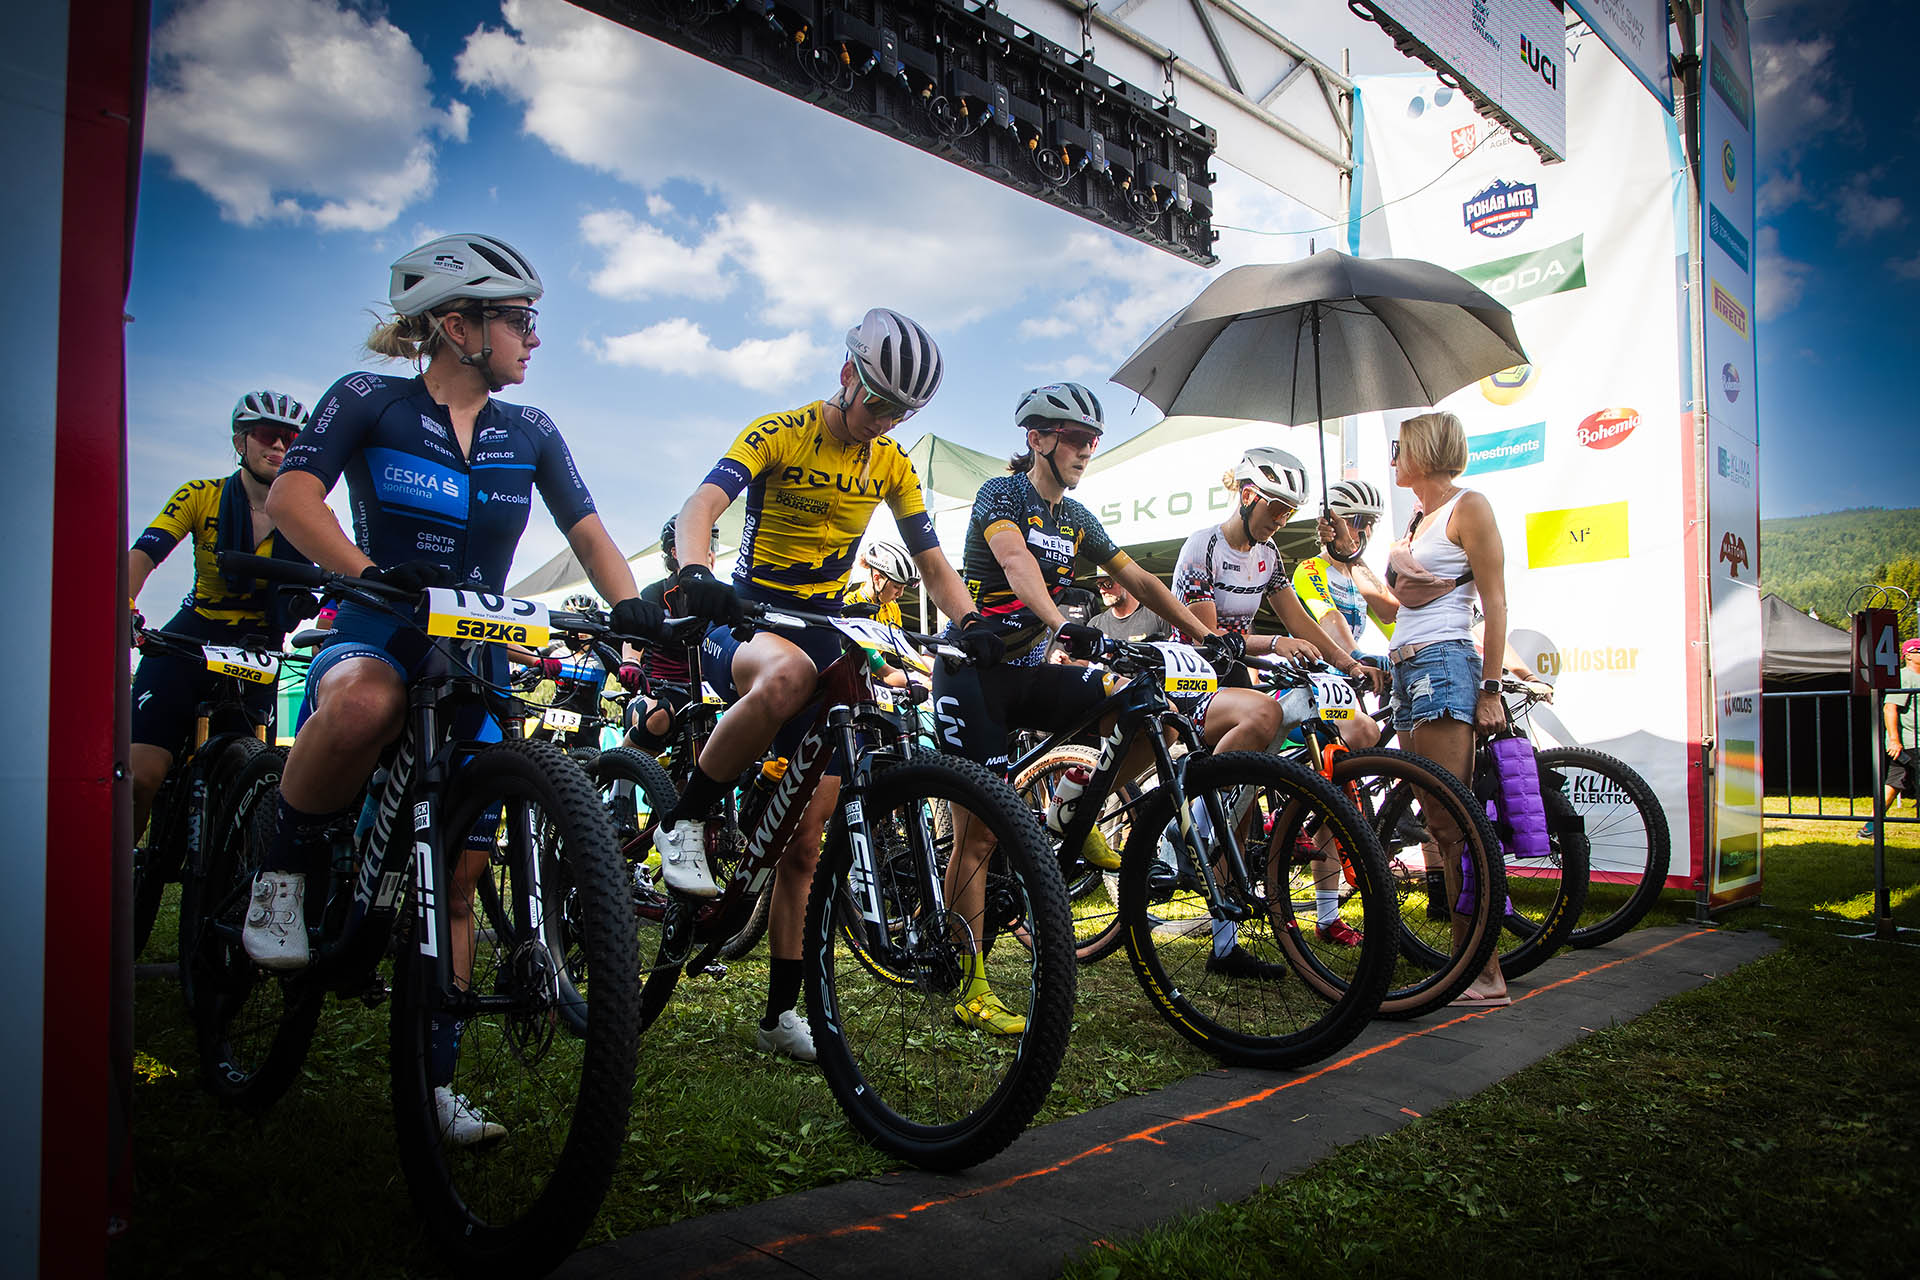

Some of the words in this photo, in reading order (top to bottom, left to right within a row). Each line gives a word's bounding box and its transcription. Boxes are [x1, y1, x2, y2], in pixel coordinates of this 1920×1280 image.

[1527, 40, 1557, 91] UCI
[1466, 194, 1506, 221] POHÁR
[1507, 188, 1534, 207] MTB
[1714, 286, 1746, 333] PIRELLI
[1576, 414, 1642, 447] Bohemia
[1467, 439, 1540, 463] nvestments
[384, 463, 440, 491] ČESKÁ
[782, 466, 885, 497] ROUVY
[358, 501, 370, 556] eticulum
[417, 531, 455, 546] CENTR
[416, 541, 455, 554] GROUP
[1045, 550, 1069, 564] NERO
[1167, 649, 1212, 673] 102
[1536, 644, 1639, 676] cyklostar
[1875, 625, 1898, 677] 4
[1322, 682, 1353, 705] 103
[551, 712, 577, 726] 113
[1573, 792, 1634, 805] ELEKTRO
[1138, 952, 1183, 1020] PIRELLI
